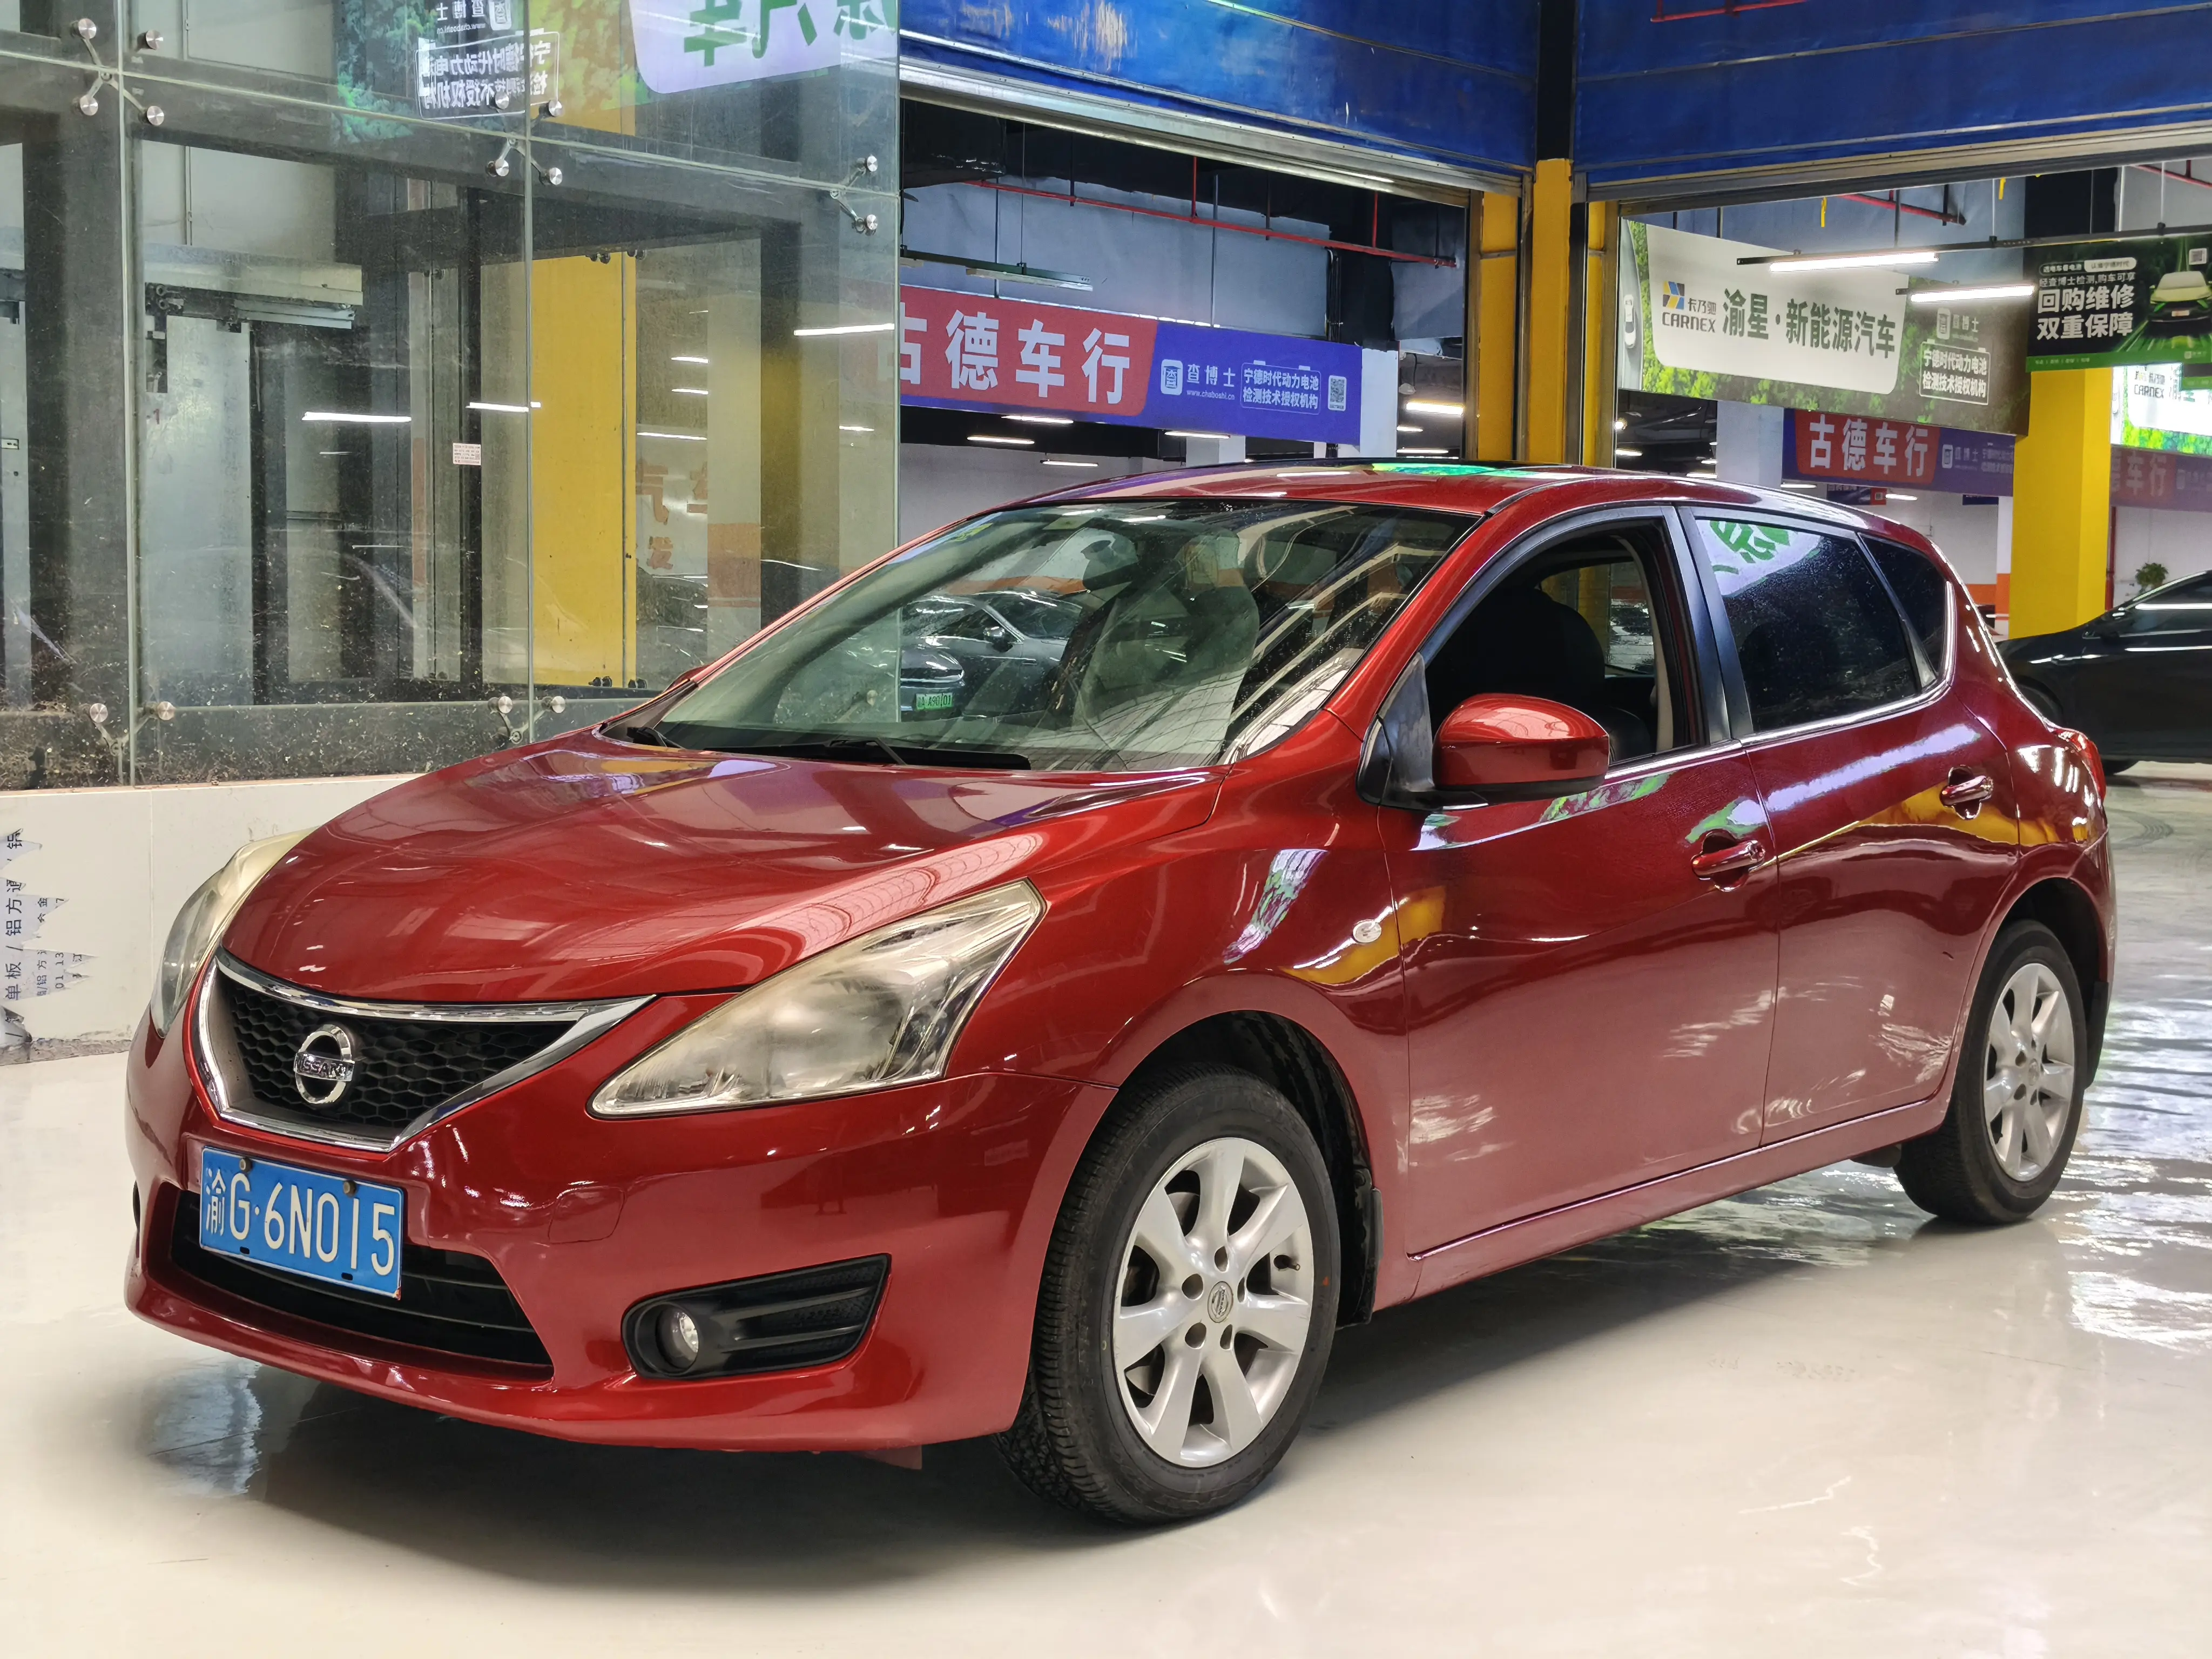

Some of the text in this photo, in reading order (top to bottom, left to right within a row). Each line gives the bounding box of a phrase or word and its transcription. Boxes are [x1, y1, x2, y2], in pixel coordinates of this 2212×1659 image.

[1688, 298, 1717, 315] 卡乃驰
[2038, 284, 2135, 314] 回购维修
[1662, 312, 1716, 333] CARNEX
[1722, 288, 1896, 359] 渝星·新能源汽车
[2036, 312, 2134, 341] 双重保障
[1187, 363, 1236, 388] 查博士
[1244, 368, 1319, 391] 宁德时代动力电池
[1243, 386, 1318, 410] 检测技术授权机构
[1809, 414, 1928, 477] 古德车行
[296, 1054, 351, 1080] NISSAN
